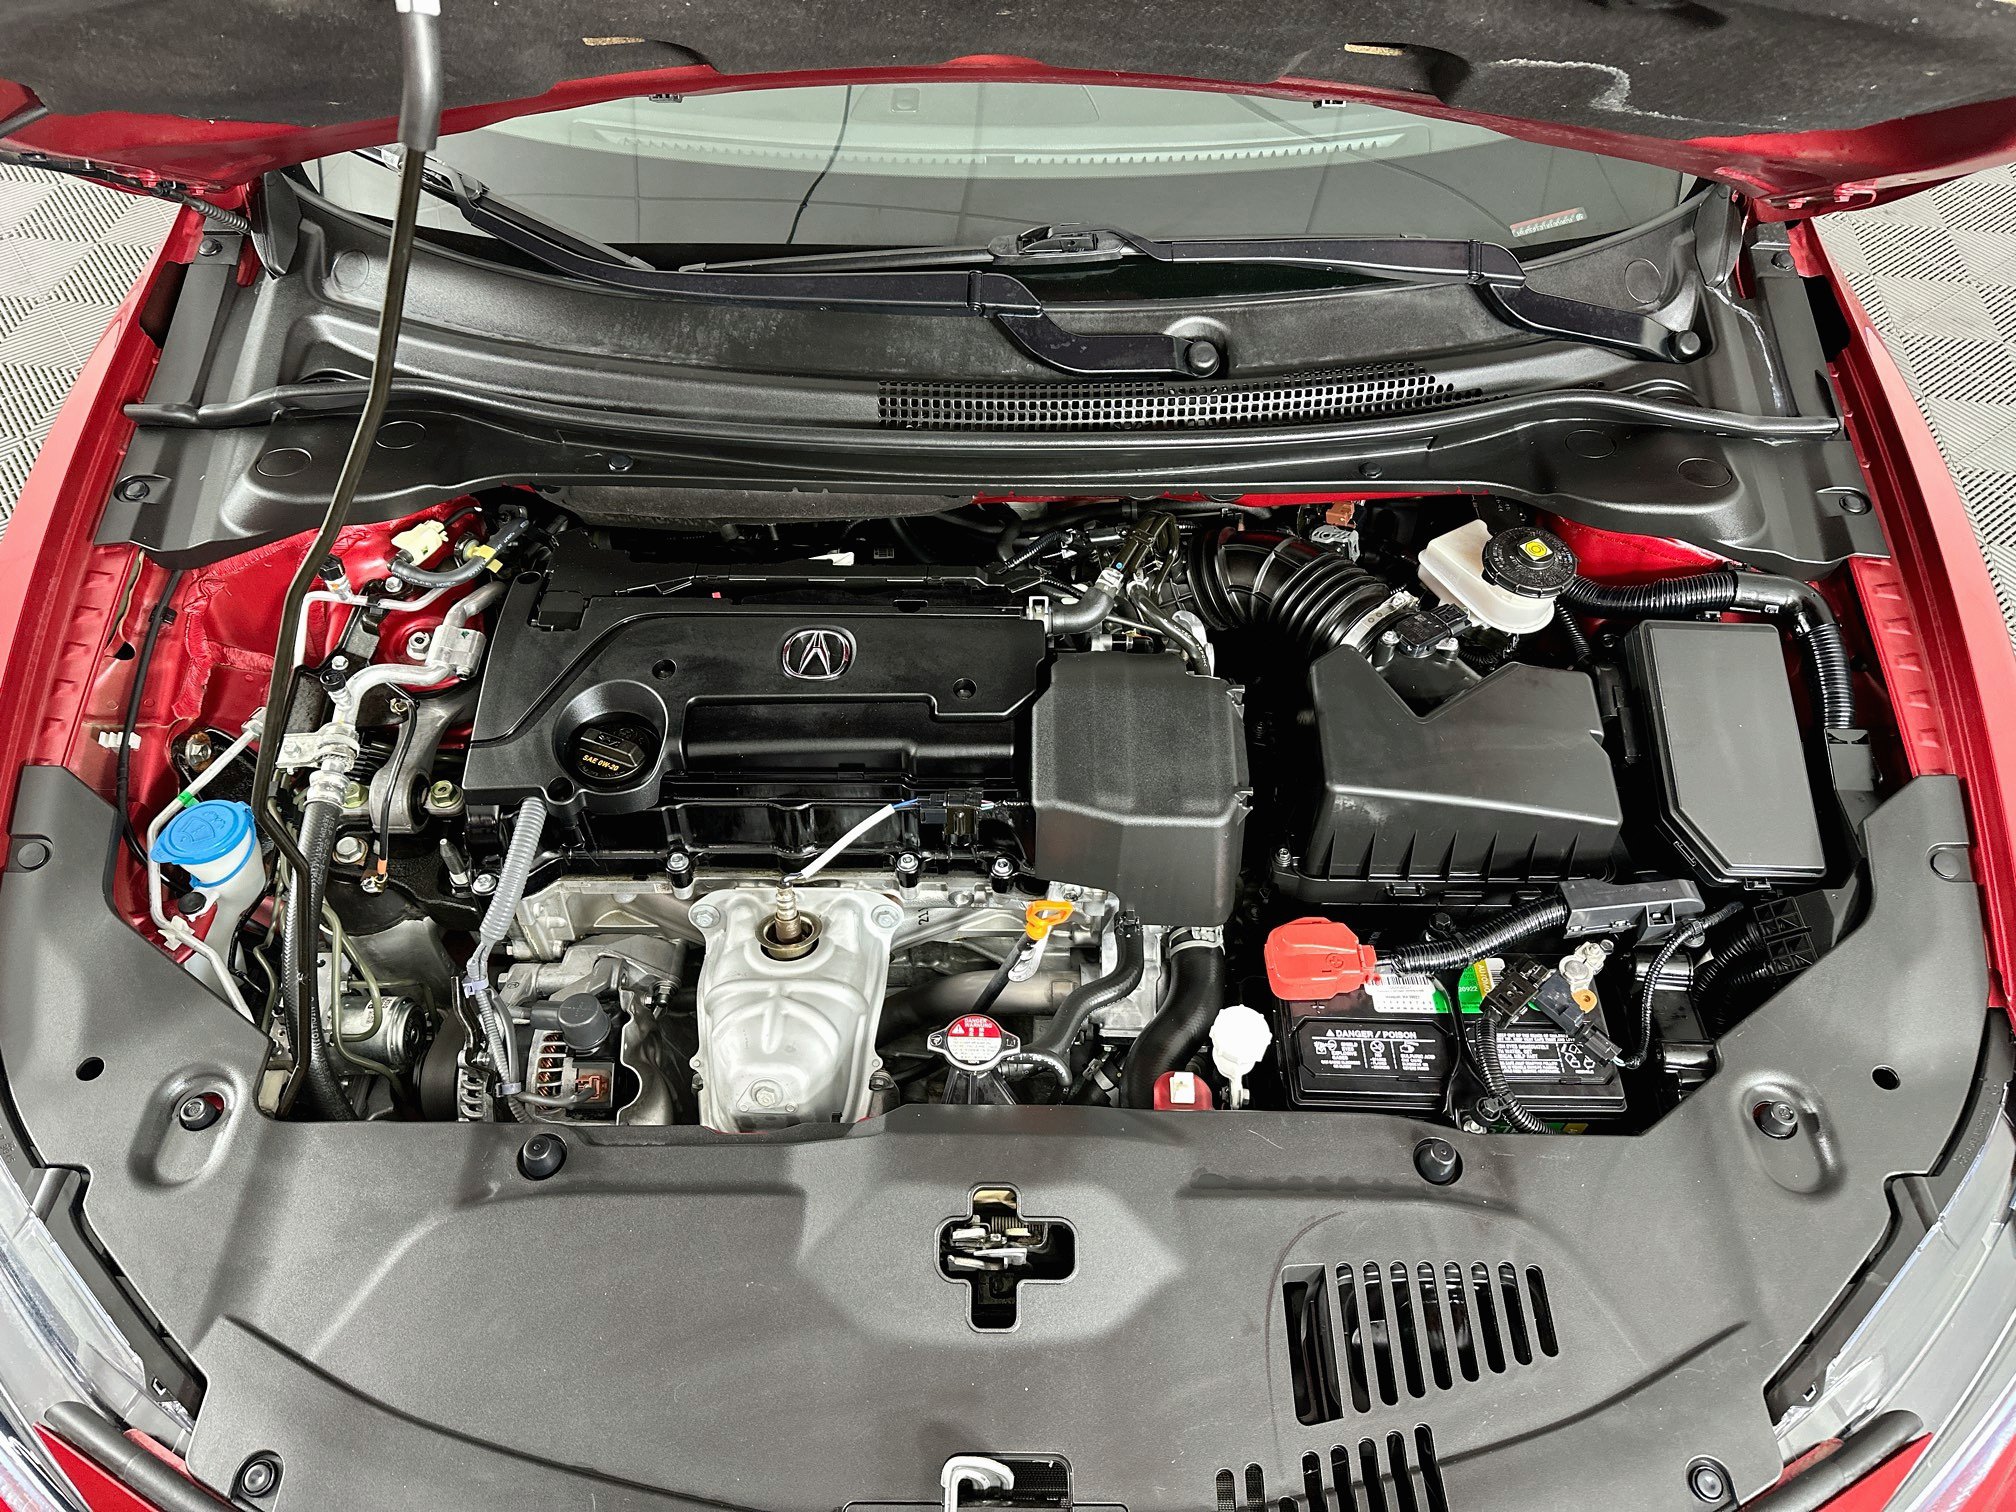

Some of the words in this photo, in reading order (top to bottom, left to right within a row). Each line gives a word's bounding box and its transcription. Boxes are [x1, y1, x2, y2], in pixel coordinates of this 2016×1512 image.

[582, 754, 598, 764] SAE
[598, 760, 620, 771] 0W-20
[1335, 1030, 1374, 1038] DANGER
[1382, 1031, 1417, 1039] POISON
